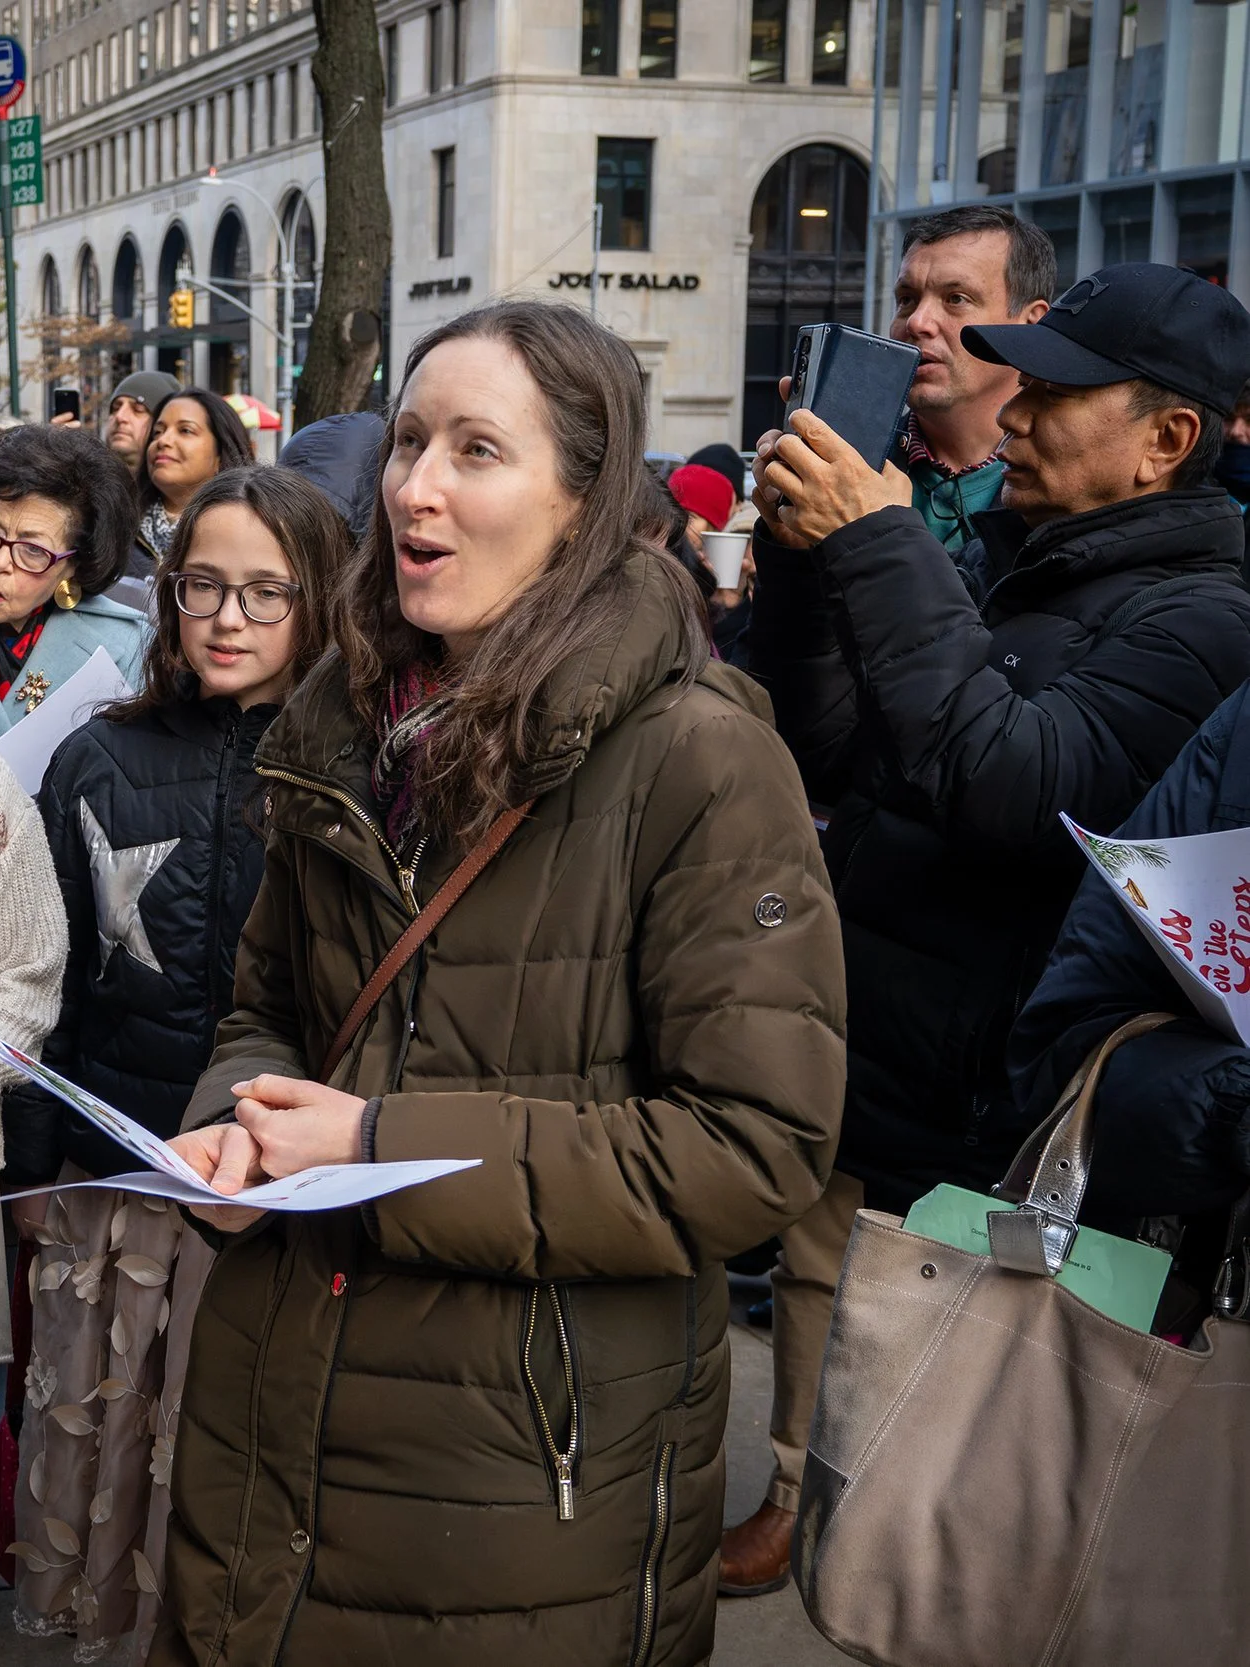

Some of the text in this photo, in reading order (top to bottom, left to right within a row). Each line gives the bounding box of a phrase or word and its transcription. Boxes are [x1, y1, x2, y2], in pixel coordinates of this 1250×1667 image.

[619, 273, 701, 289] SALAD
[1004, 653, 1021, 667] CK
[758, 902, 784, 918] MK
[1203, 919, 1232, 993] on the
